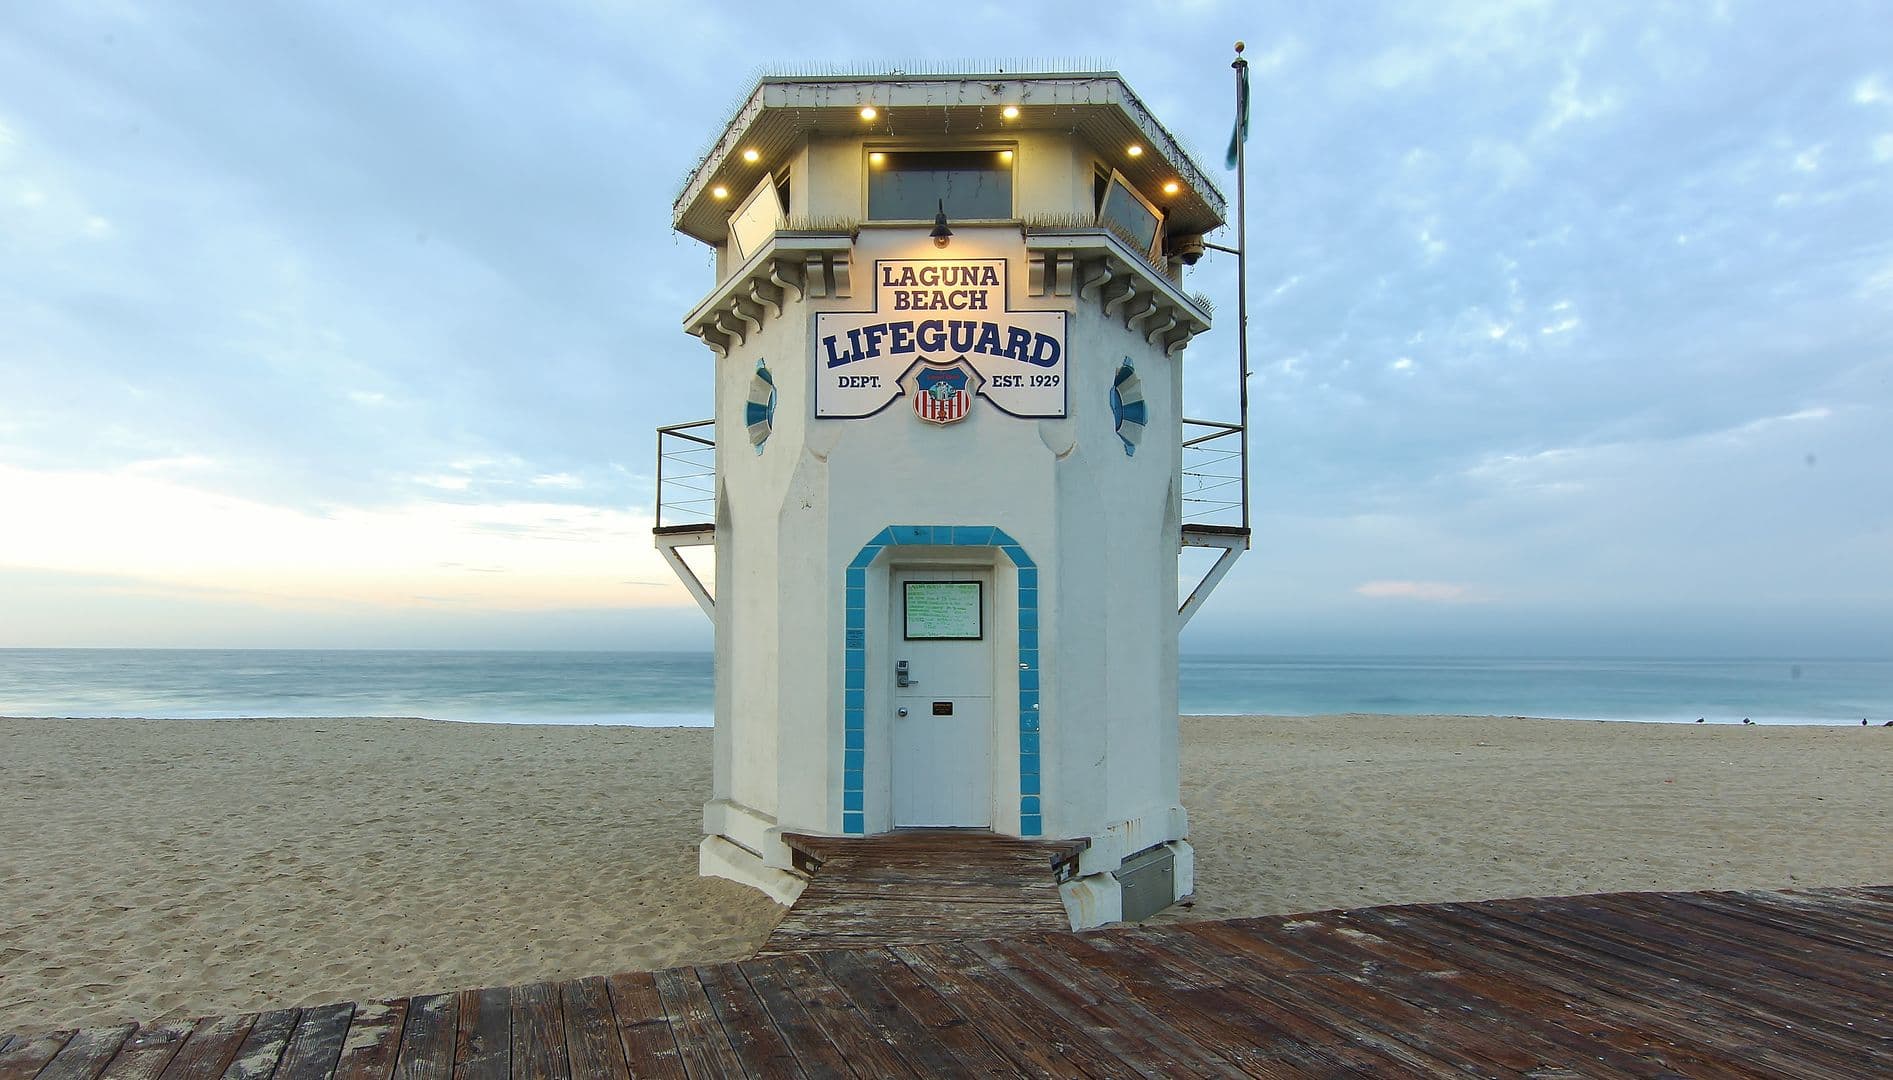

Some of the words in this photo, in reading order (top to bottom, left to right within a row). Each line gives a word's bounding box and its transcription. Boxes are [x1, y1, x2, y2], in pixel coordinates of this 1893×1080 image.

[883, 267, 999, 287] LAGUNA
[894, 290, 988, 310] BEACH
[823, 320, 1061, 368] LIFEGUARD
[838, 376, 881, 387] DEPT.
[992, 375, 1024, 387] EST.
[1030, 375, 1060, 387] 1929
